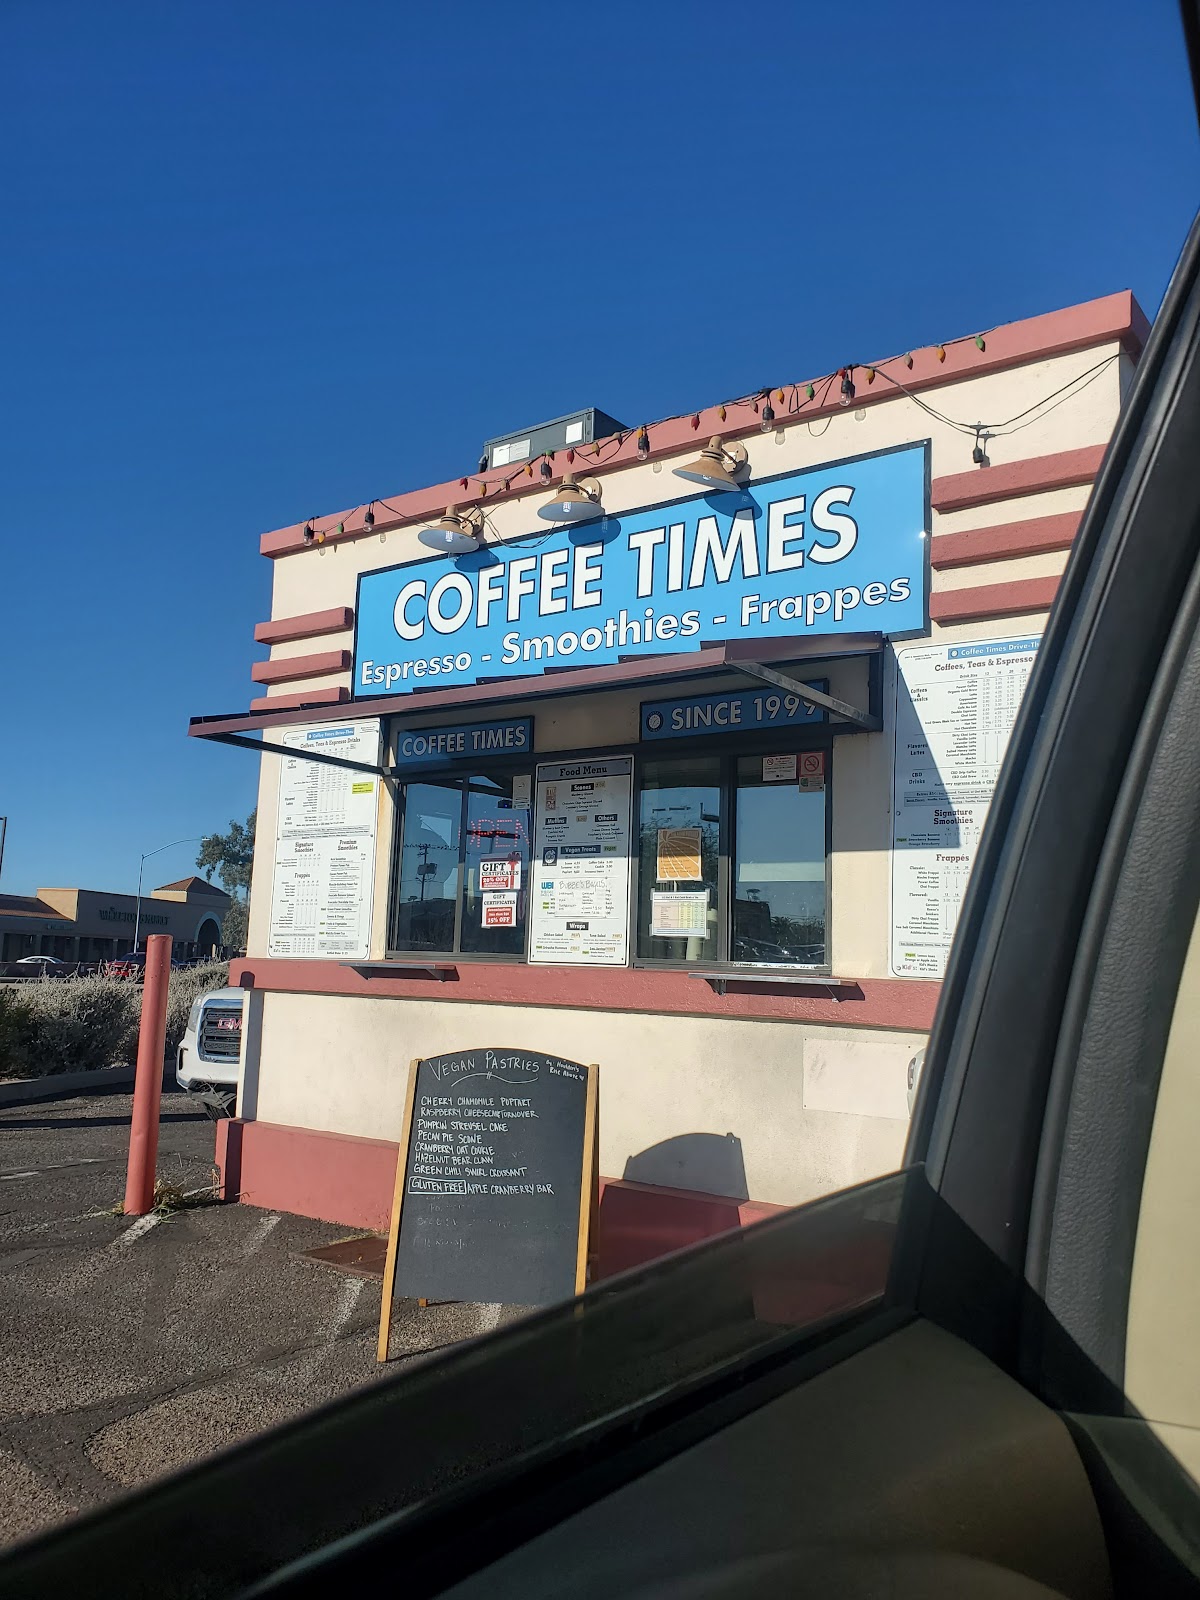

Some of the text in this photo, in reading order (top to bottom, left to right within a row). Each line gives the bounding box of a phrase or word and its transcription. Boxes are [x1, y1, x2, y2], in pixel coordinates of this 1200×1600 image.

[393, 485, 859, 641] COFFEE TIMES
[360, 650, 472, 690] Espresso
[501, 604, 701, 665] Smoothies
[741, 576, 911, 629] Frappes
[961, 647, 983, 656] Coffee
[986, 644, 1006, 652] Times
[934, 664, 966, 672] Coffees,
[996, 656, 1033, 666] Espresso
[670, 700, 742, 732] SINCE
[401, 725, 526, 758] COFFEE TIMES
[560, 766, 607, 777] Food Menu
[934, 810, 973, 818] Signature
[936, 854, 970, 863] Frappés
[482, 863, 506, 871] GIFT
[429, 1050, 540, 1081] VEGAN PASTRIES
[421, 1096, 453, 1106] CHERRY
[500, 1097, 531, 1107] POPTART
[420, 1107, 462, 1118] RASPBERRY
[417, 1119, 508, 1131] PUMPKIN STREUSEL CAKE
[418, 1131, 482, 1144] PECAN PIE SCONE
[415, 1142, 495, 1155] CRANBERRY OAT COOKIE
[415, 1153, 450, 1164] HAZELNUT
[452, 1156, 472, 1165] BEAR
[414, 1164, 442, 1175] GREEN
[489, 1167, 527, 1177] CROISSANT
[412, 1179, 554, 1196] GLUTEN FREE APPLE CRANBERRY BAR
